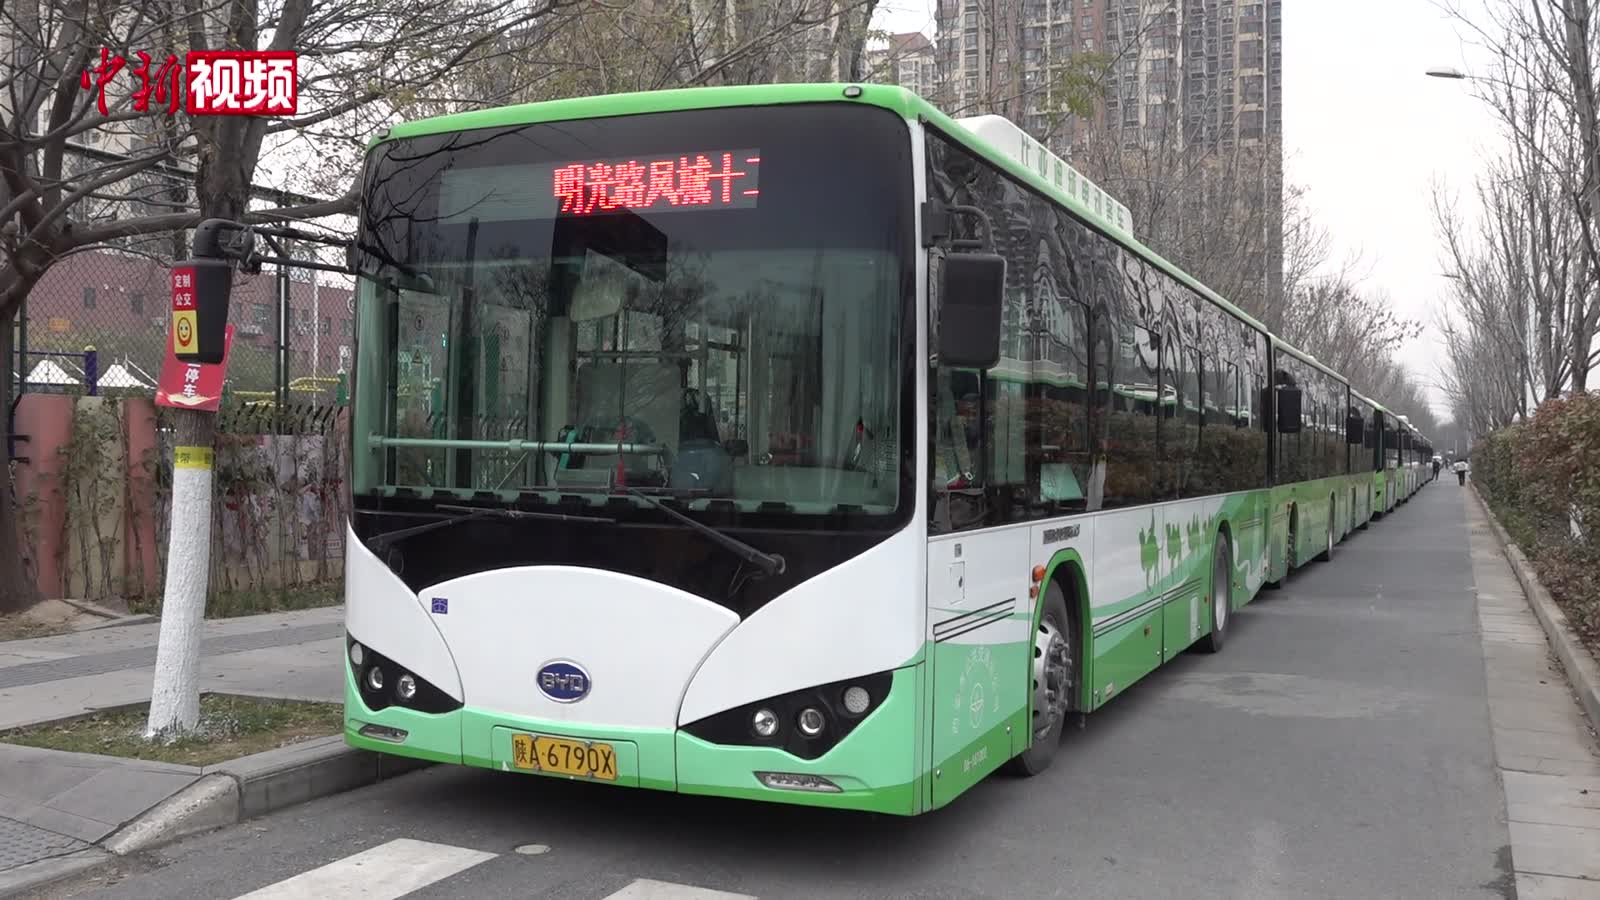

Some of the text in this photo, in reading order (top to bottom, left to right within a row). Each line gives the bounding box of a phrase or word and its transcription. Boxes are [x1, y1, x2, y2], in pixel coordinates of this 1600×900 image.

[175, 274, 191, 288] 定制
[175, 292, 192, 306] 公交
[183, 363, 201, 398] 停车
[542, 671, 584, 692] BYD
